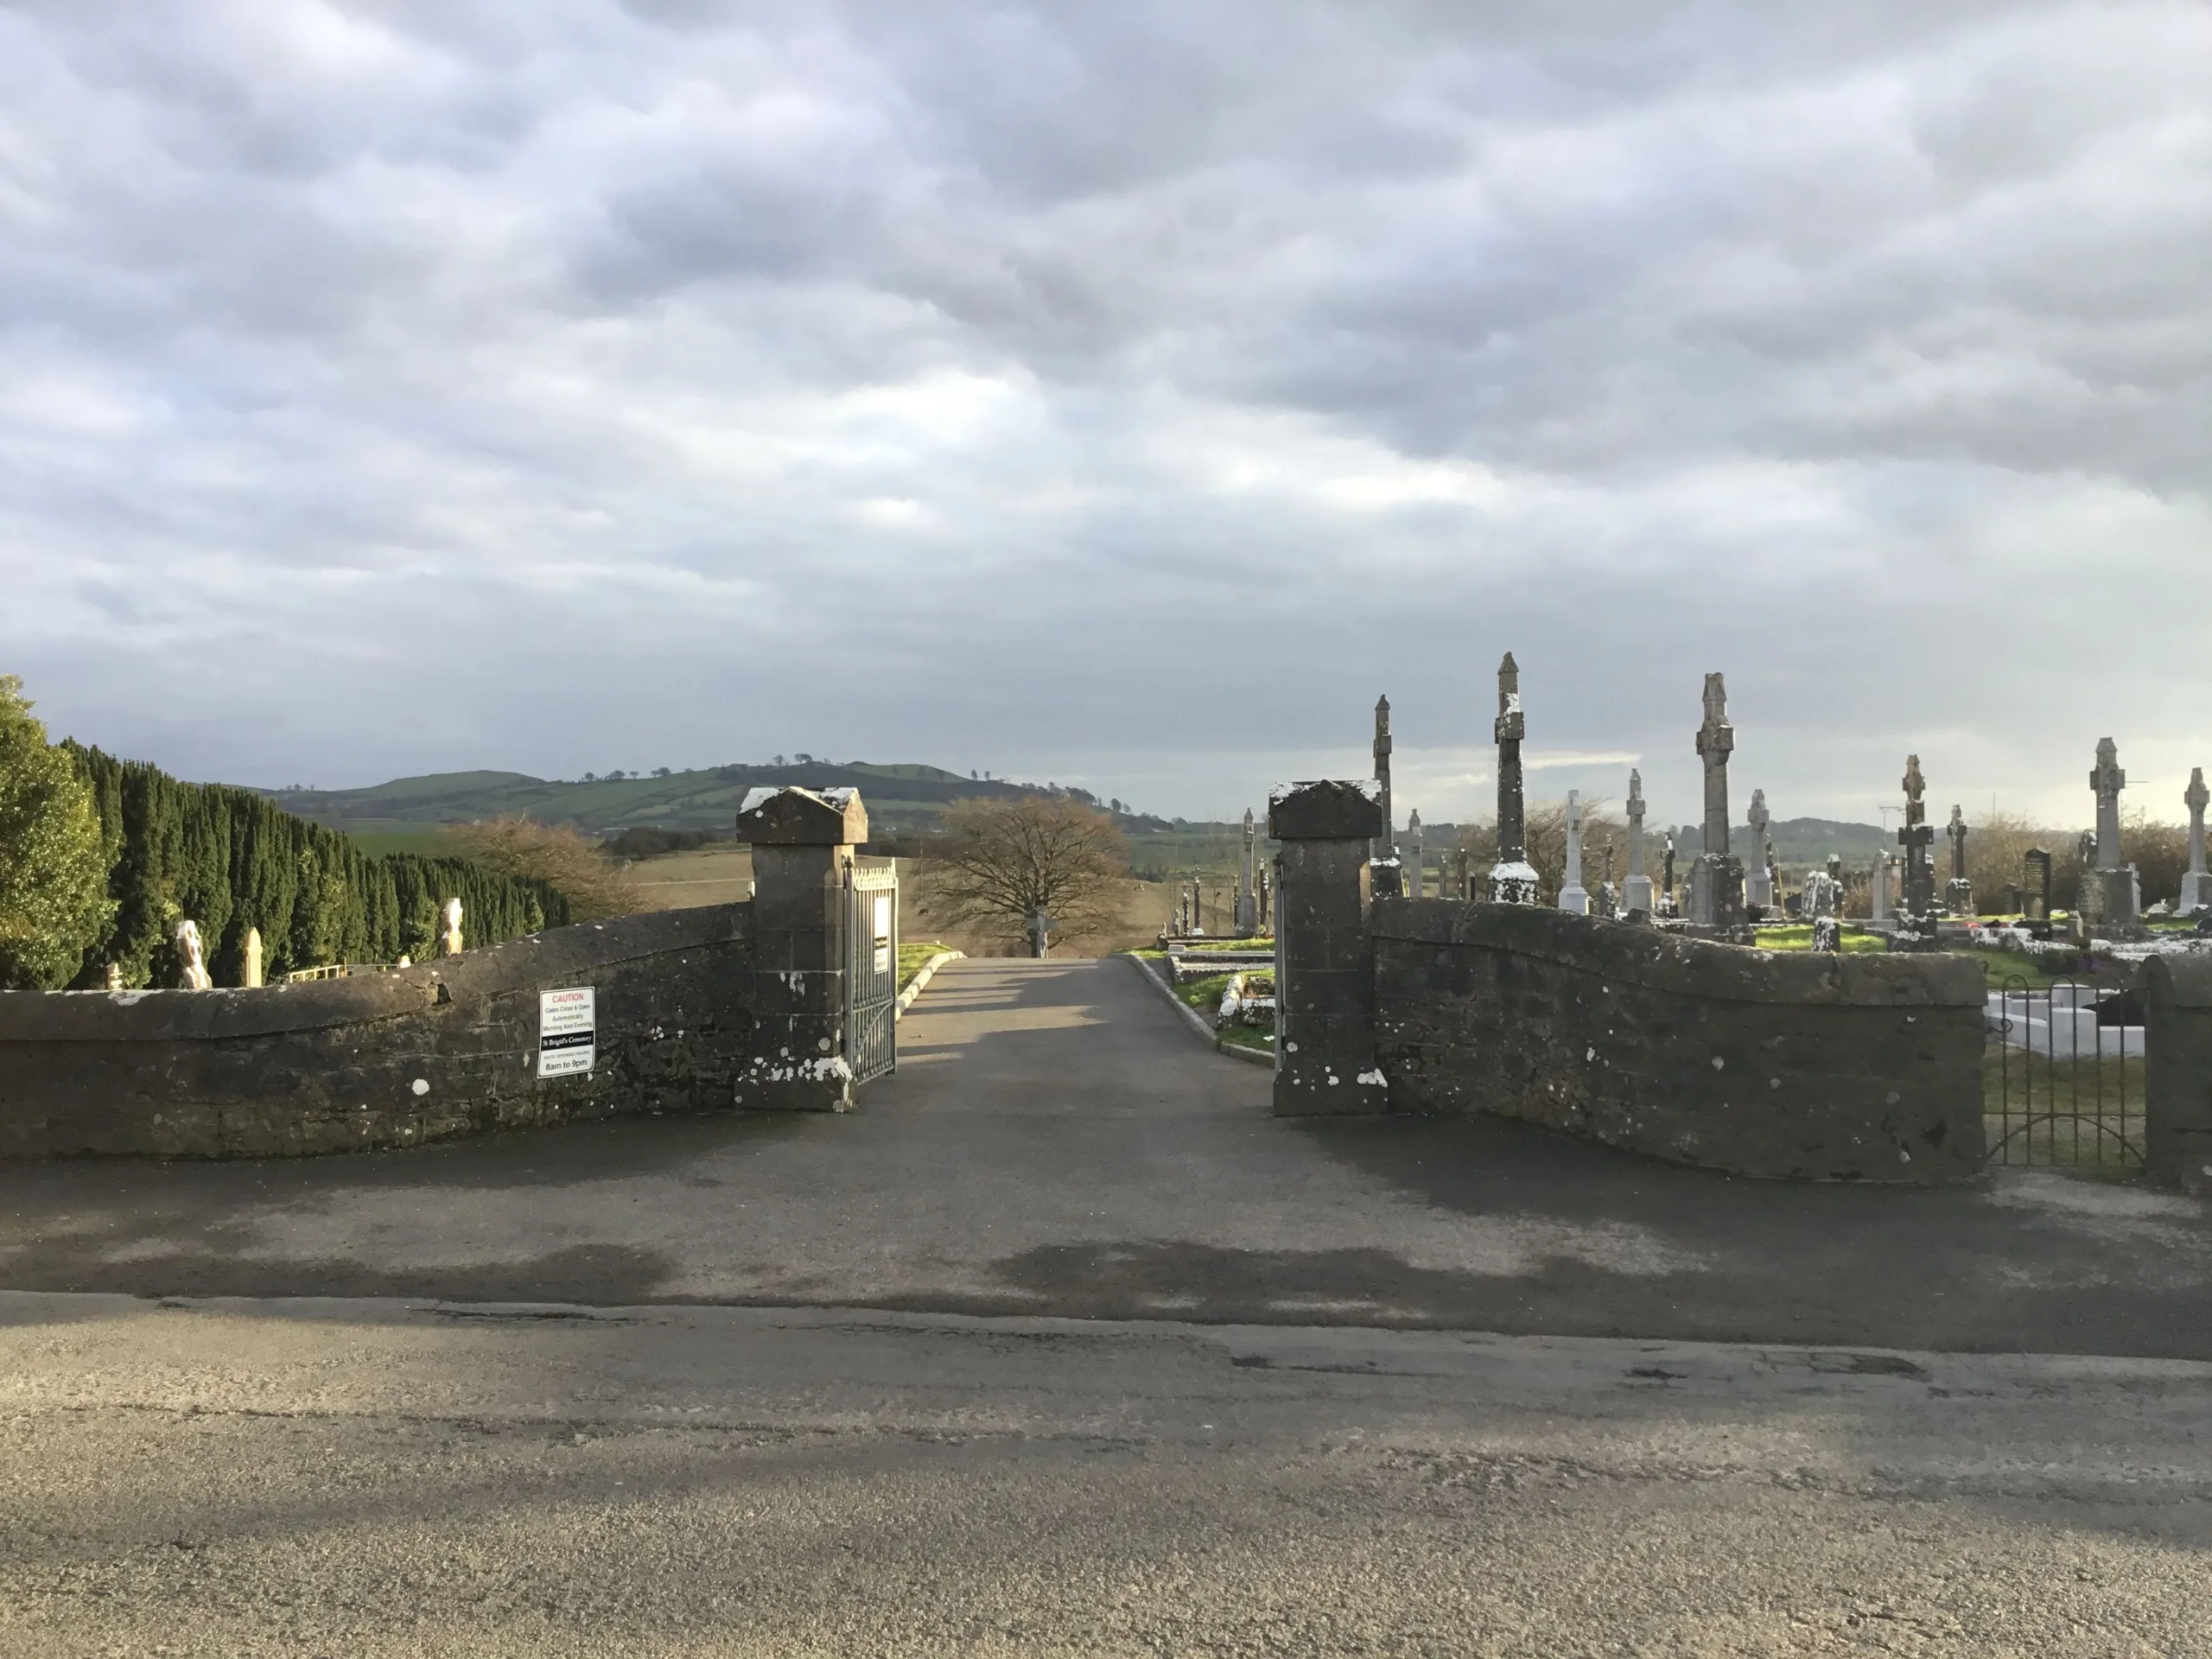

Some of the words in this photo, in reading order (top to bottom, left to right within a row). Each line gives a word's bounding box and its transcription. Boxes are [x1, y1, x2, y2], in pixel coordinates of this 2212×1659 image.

[552, 993, 583, 1003] CAUTION
[549, 1038, 568, 1046] Brigid's
[572, 1059, 587, 1068] 9pm
